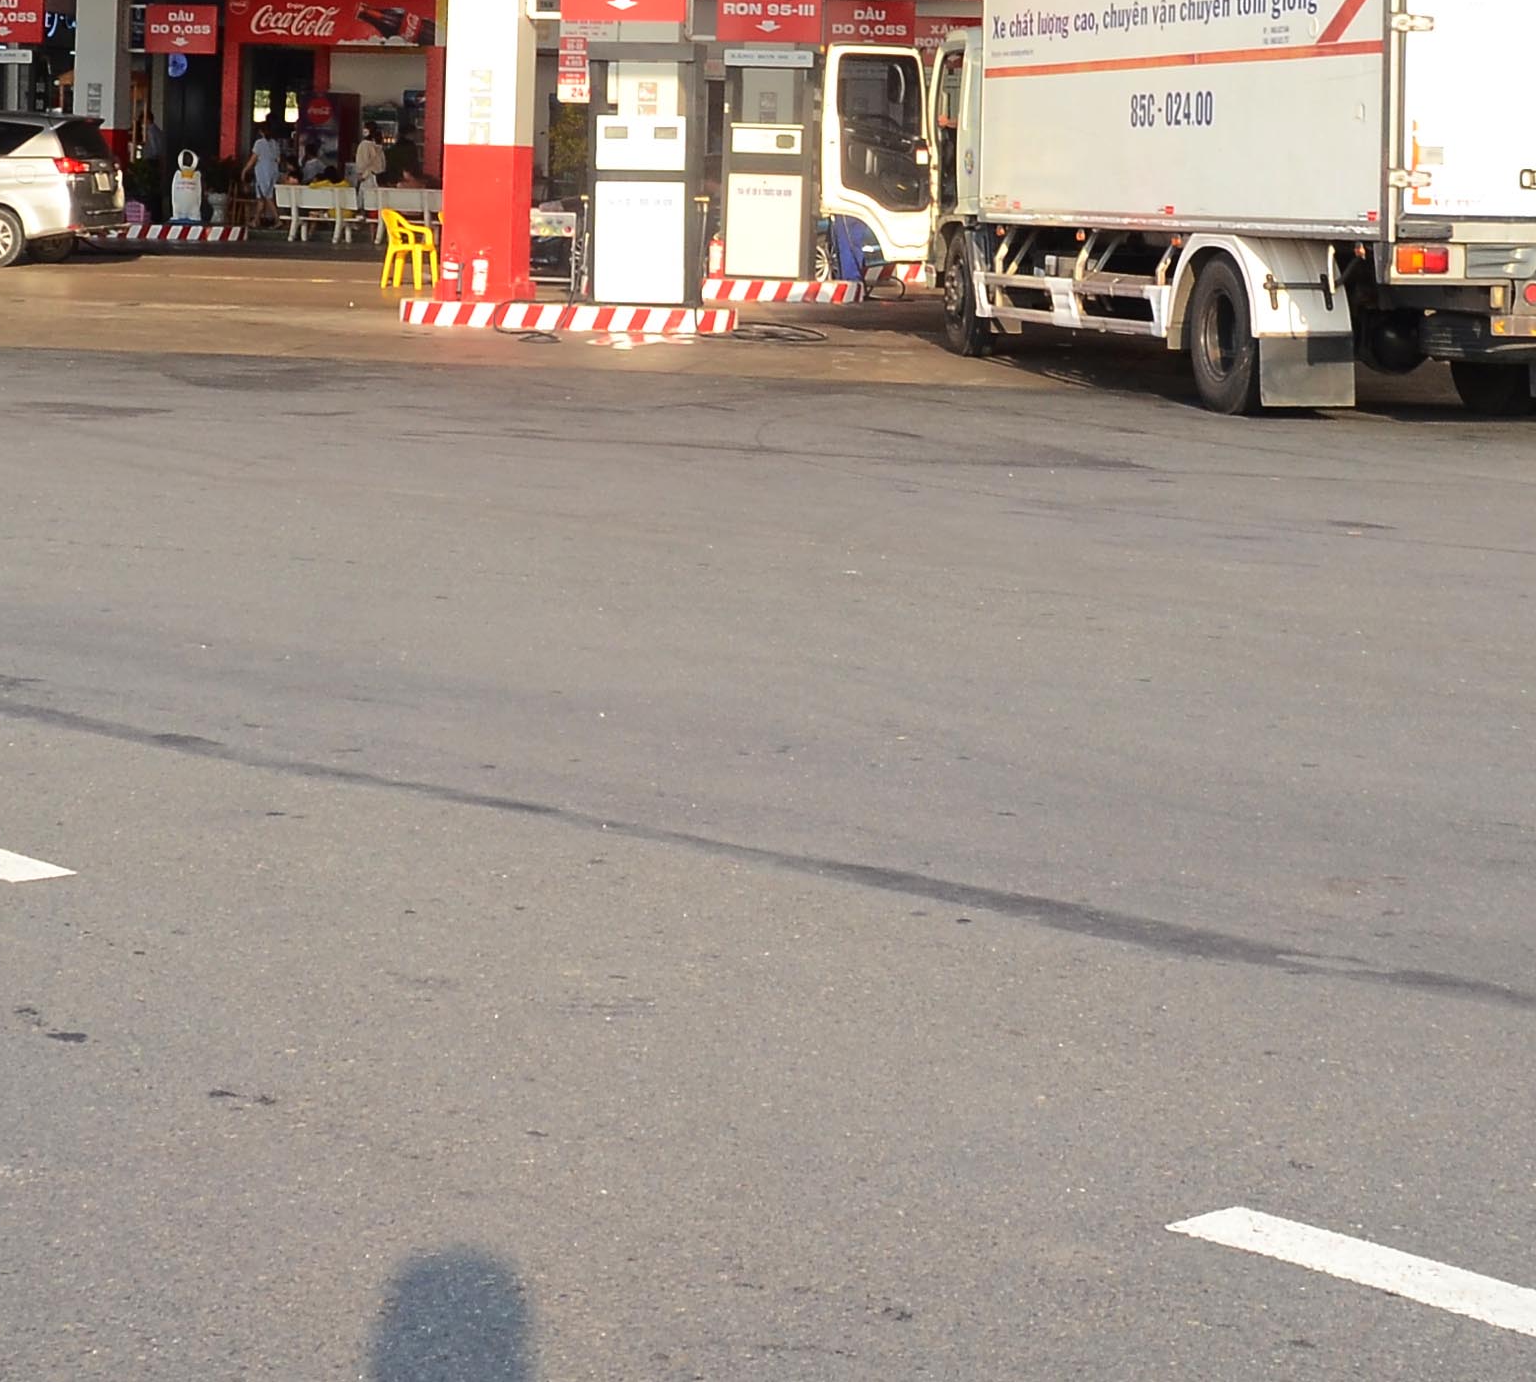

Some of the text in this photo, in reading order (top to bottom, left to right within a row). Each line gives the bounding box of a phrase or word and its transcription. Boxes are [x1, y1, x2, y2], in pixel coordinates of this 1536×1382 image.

[722, 3, 815, 17] RON 95-III
[250, 3, 340, 37] Coca-Cola
[992, 15, 1006, 40] Xe
[1009, 9, 1034, 38] chất
[1037, 11, 1070, 42] lượng
[1073, 12, 1099, 36] cao,
[1102, 1, 1149, 34] chuyên
[150, 24, 169, 34] DO
[832, 24, 907, 37] DO 0,05S
